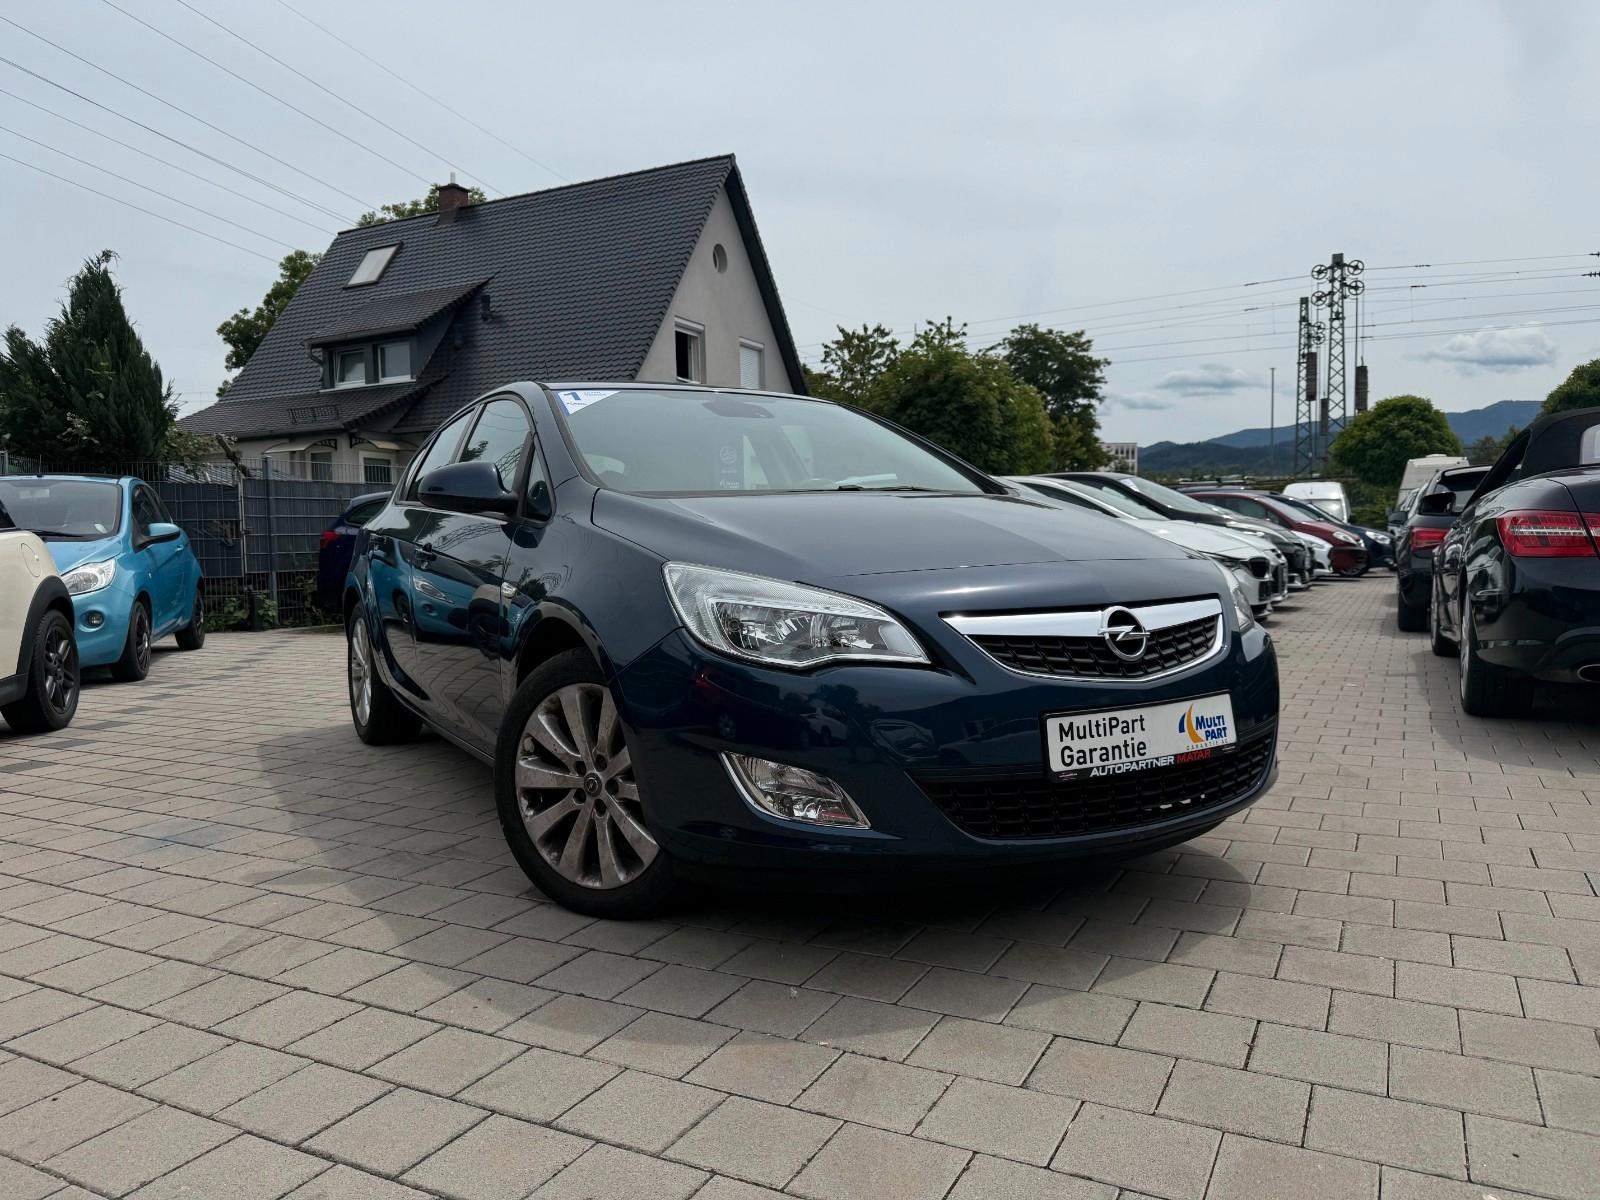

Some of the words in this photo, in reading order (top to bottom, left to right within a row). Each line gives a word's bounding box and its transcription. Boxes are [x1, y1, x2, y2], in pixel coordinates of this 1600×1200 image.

[1058, 714, 1146, 743] MultiPart
[1195, 714, 1225, 731] MULTI
[1205, 726, 1228, 741] PART
[1060, 737, 1147, 767] Garantie
[1089, 755, 1175, 778] AUTOPARTNER
[1176, 749, 1212, 764] MATAR
